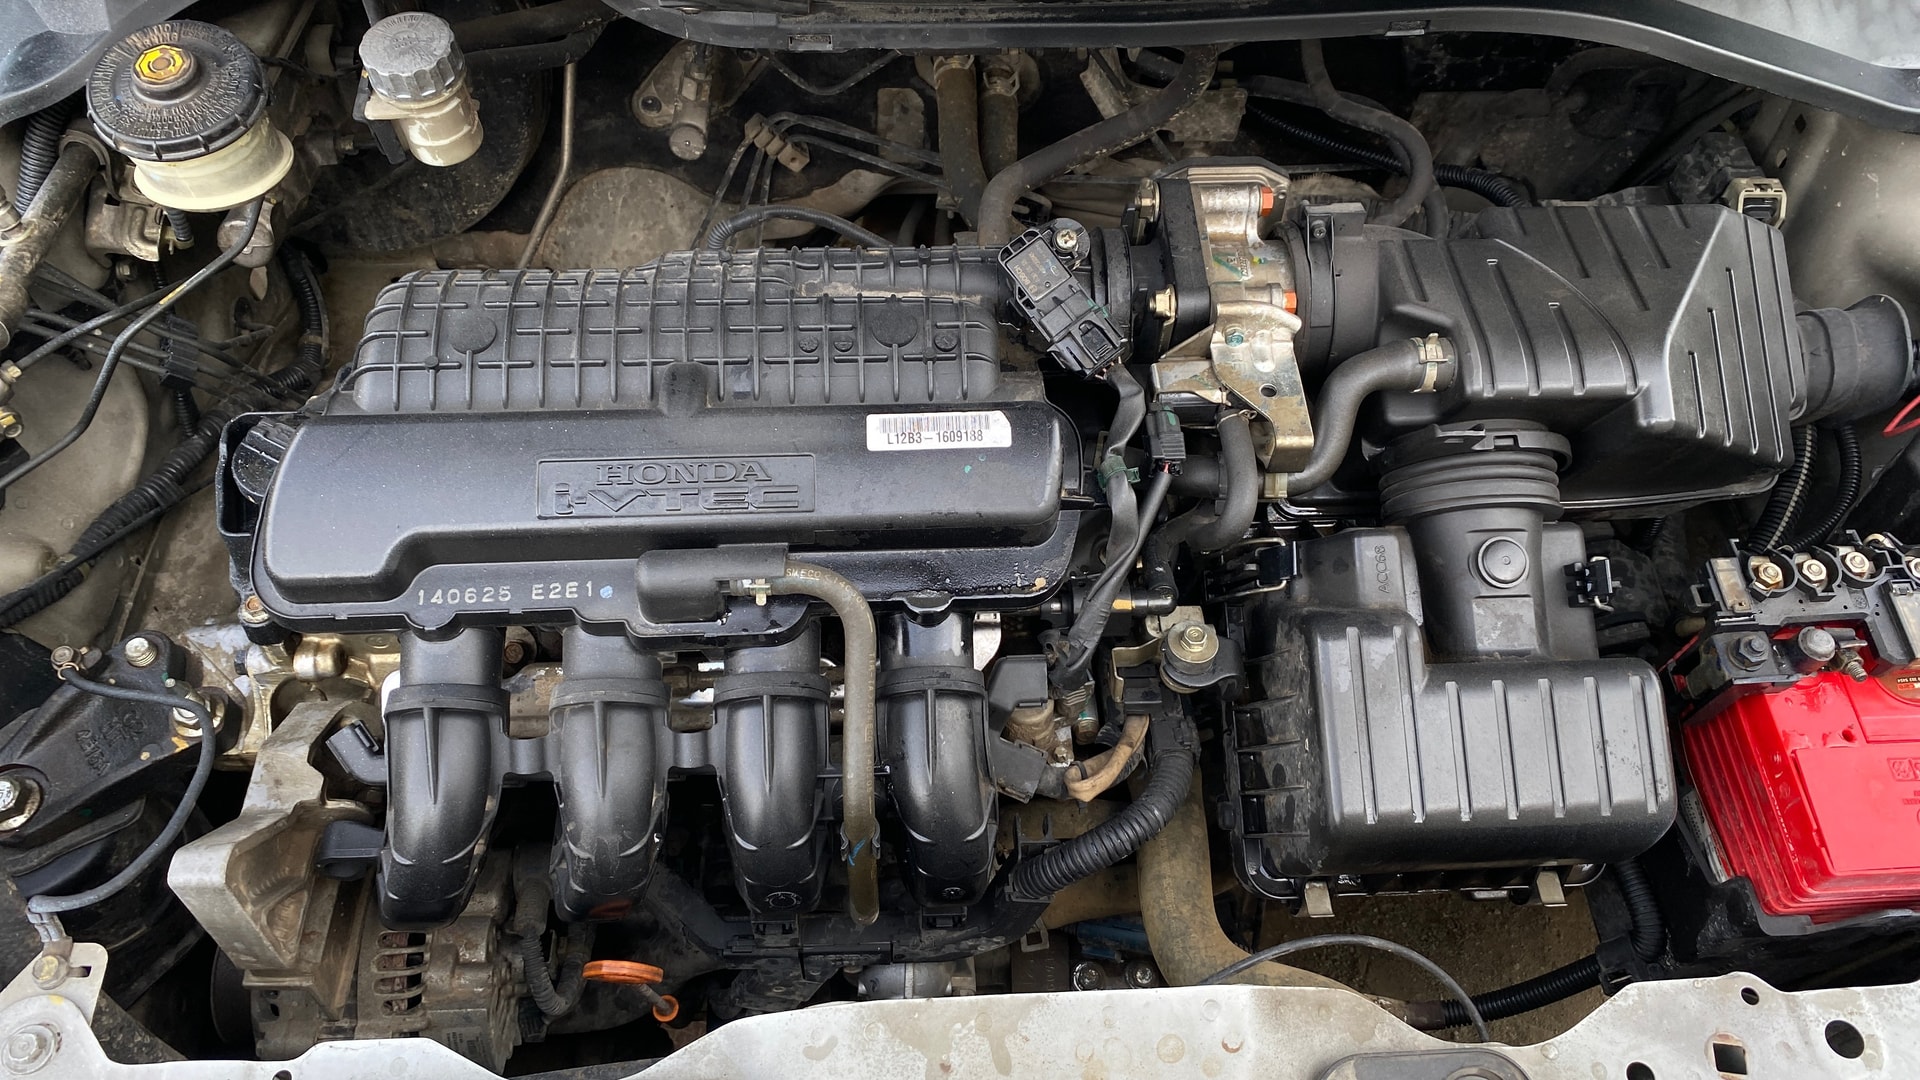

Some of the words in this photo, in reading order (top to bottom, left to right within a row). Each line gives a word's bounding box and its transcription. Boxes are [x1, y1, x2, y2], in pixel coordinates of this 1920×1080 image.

[596, 460, 772, 486] HONDA
[554, 483, 799, 515] i-VTEC
[418, 585, 512, 606] 140625
[531, 581, 593, 600] E2E1
